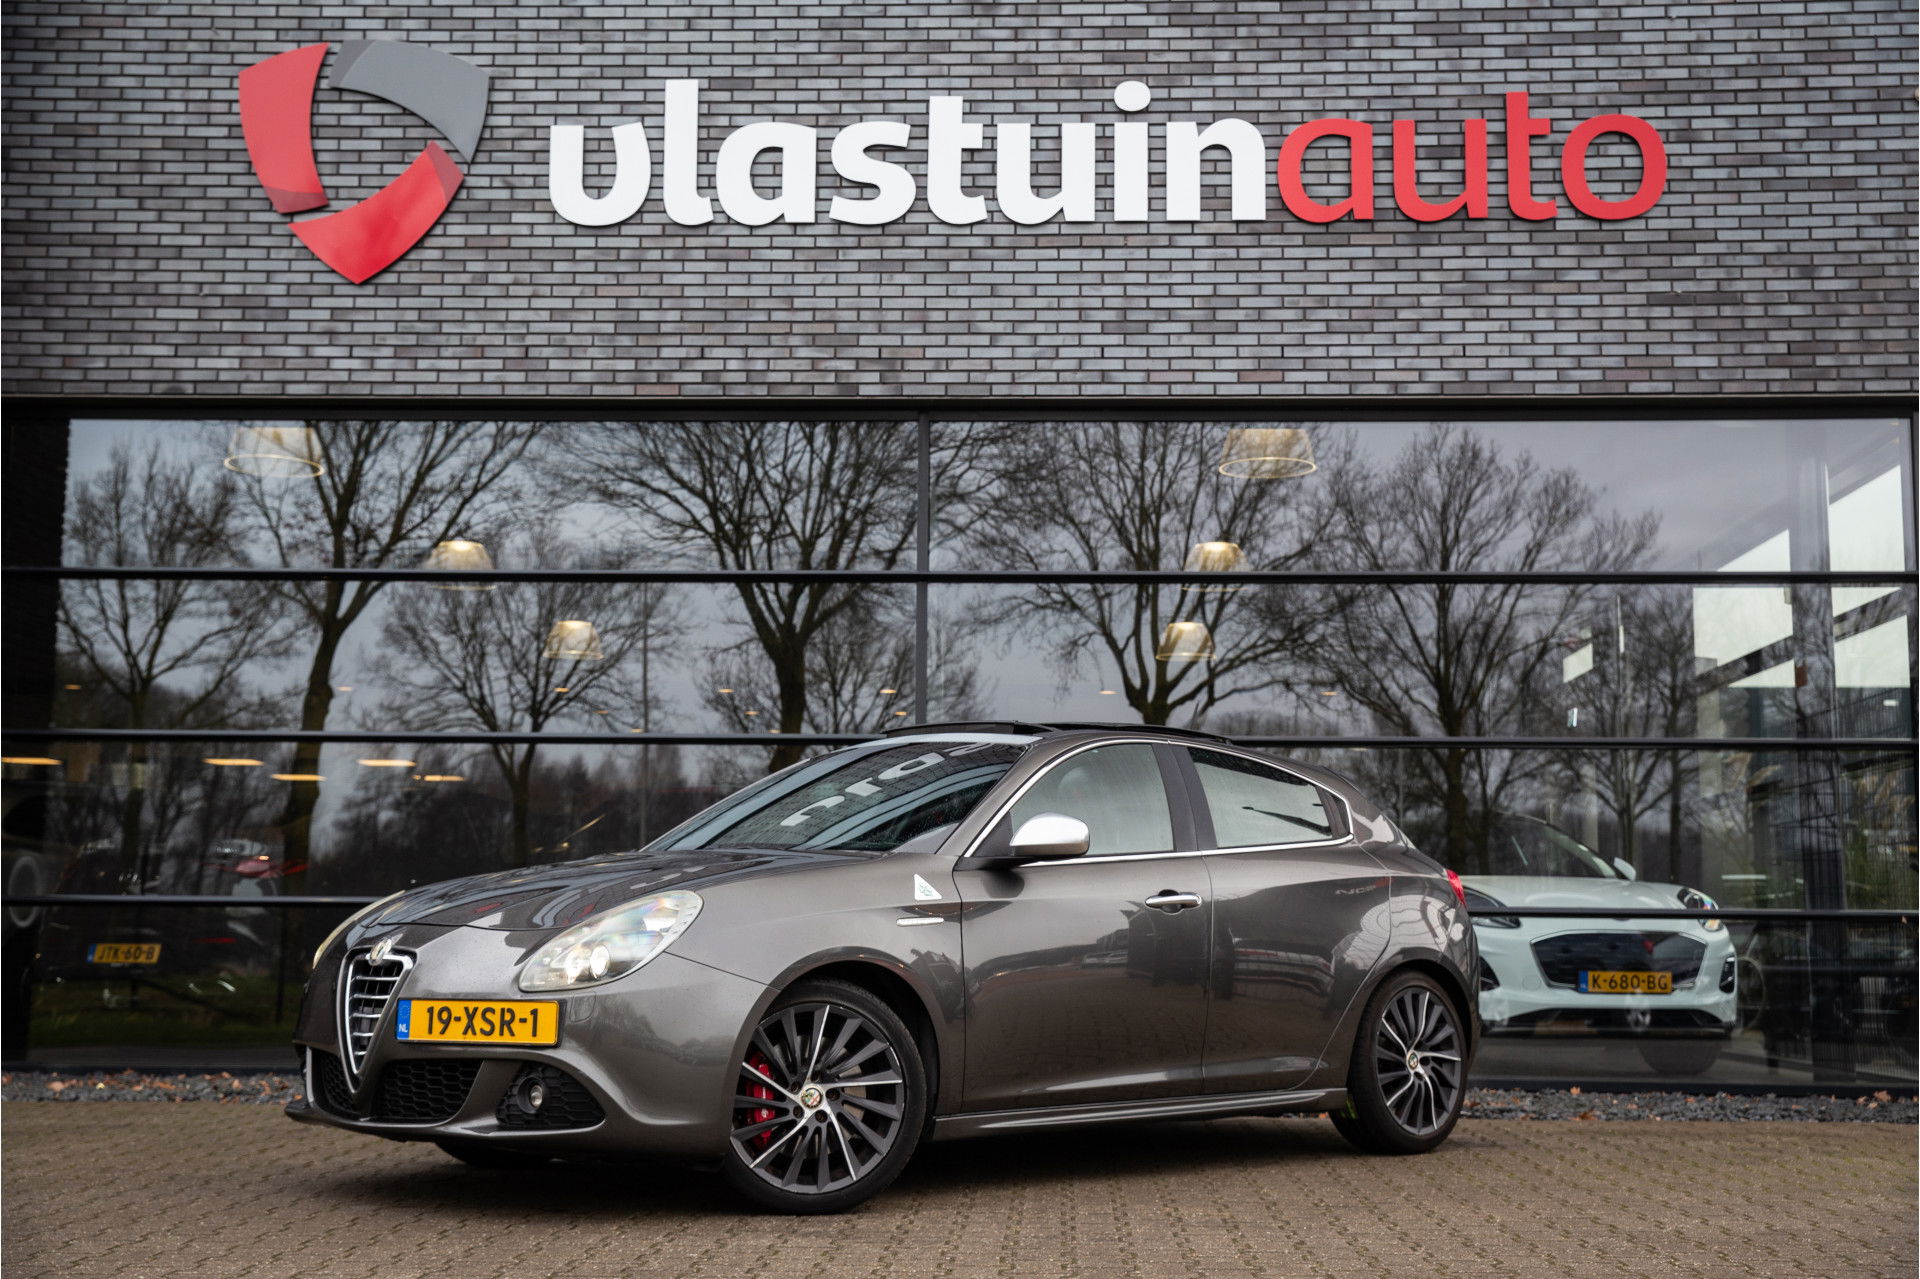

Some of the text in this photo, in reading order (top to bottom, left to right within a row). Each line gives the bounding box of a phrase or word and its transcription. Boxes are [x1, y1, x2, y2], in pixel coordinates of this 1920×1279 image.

[1592, 974, 1668, 990] K-680-BG
[398, 1024, 409, 1033] NL
[426, 1006, 539, 1037] 19-XSR-1
